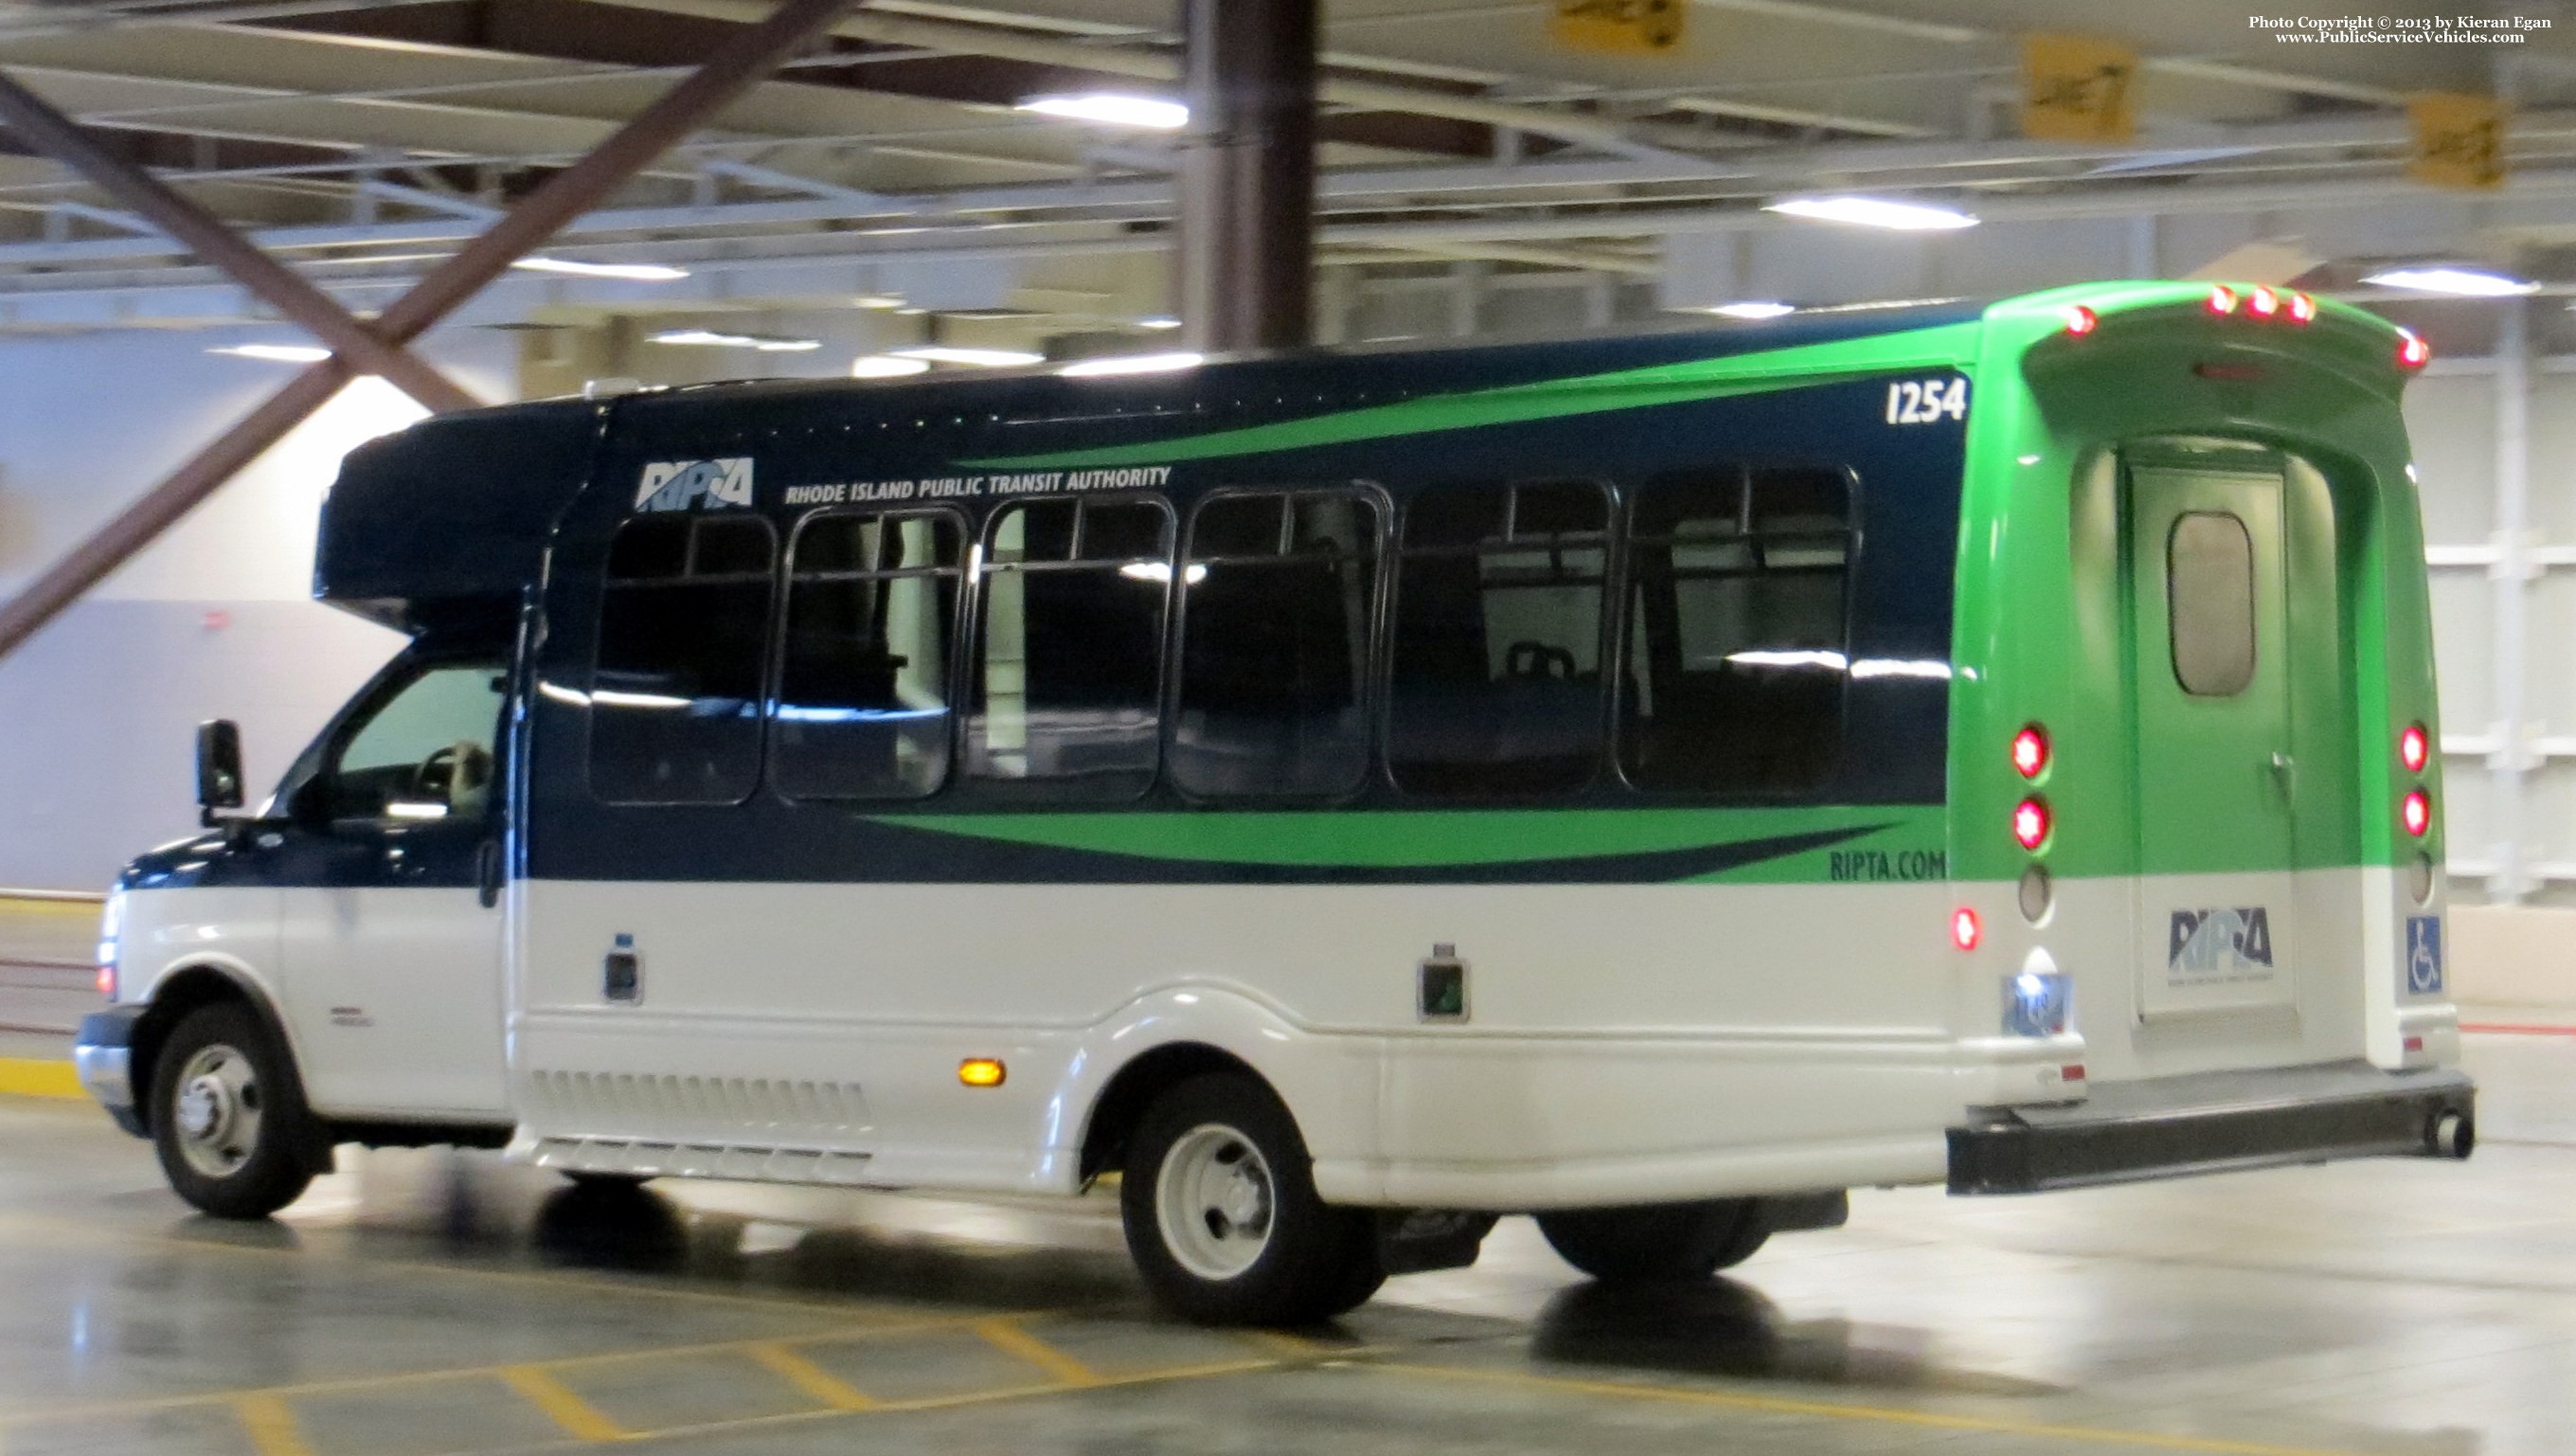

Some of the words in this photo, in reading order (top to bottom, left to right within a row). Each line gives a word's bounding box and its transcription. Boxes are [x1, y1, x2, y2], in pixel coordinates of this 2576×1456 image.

[1886, 377, 1967, 425] 1254
[635, 457, 755, 512] RIPTA
[784, 483, 847, 504] RHODE
[850, 479, 914, 501] ISLAND
[919, 476, 984, 498] PUBLIC
[988, 473, 1064, 494] TRANSIT
[1064, 466, 1172, 491] AUTHORITY
[1829, 851, 1947, 881] RIPTA.COM
